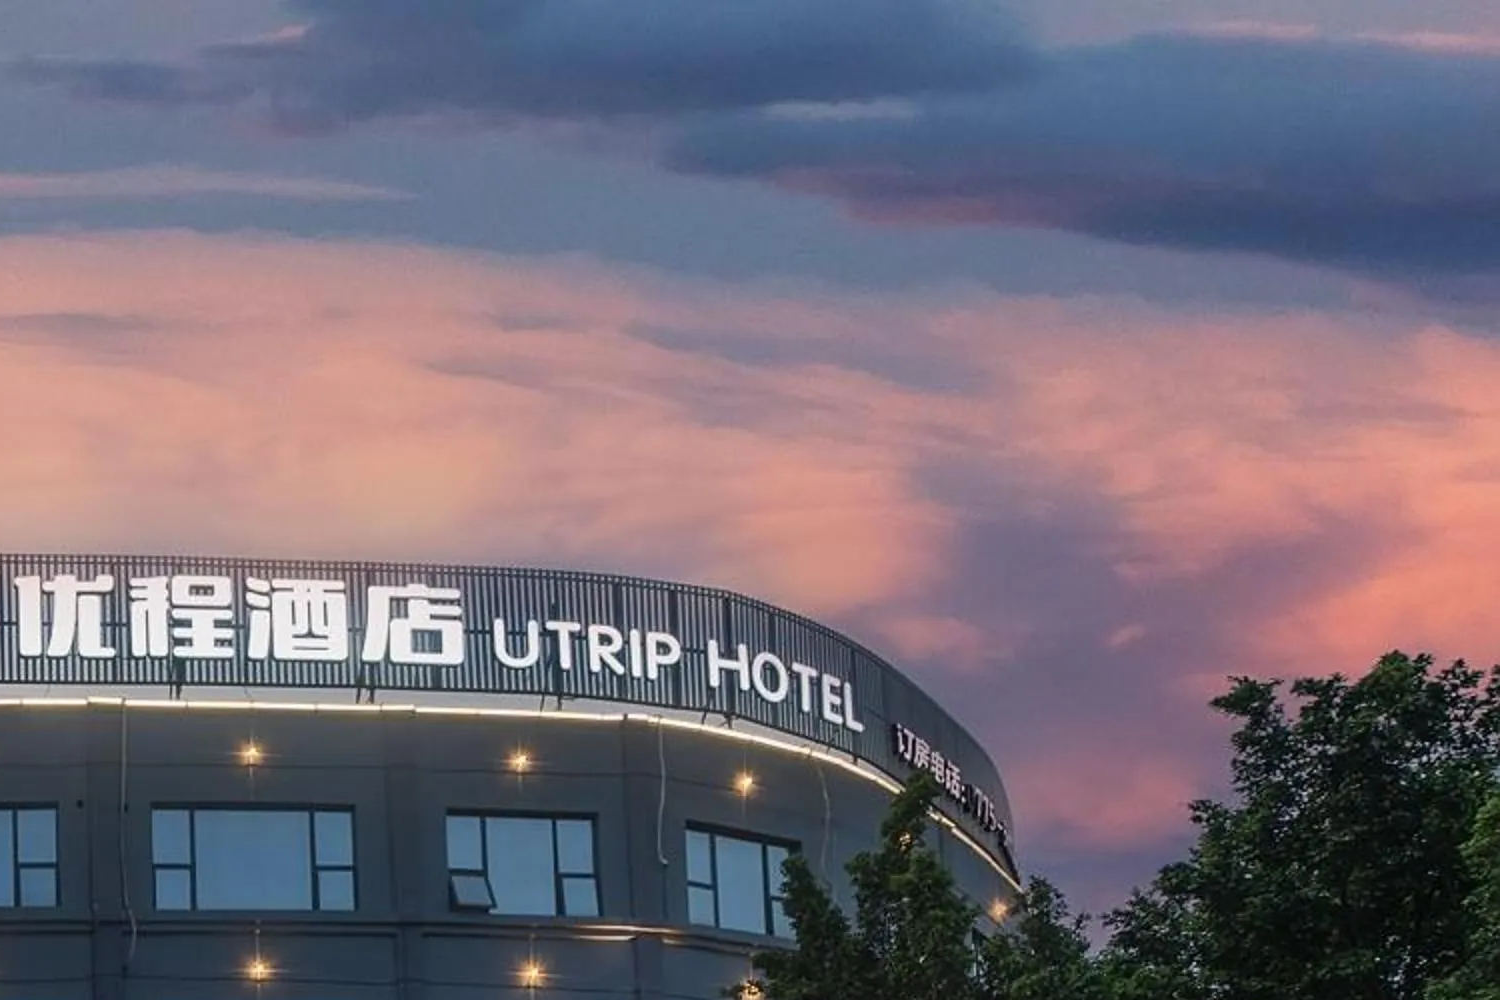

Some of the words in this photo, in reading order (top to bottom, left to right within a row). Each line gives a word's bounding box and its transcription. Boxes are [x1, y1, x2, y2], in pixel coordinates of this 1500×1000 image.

[13, 574, 464, 665] 优程酒店
[493, 619, 681, 681] UTRIP
[707, 639, 865, 733] HOTEL
